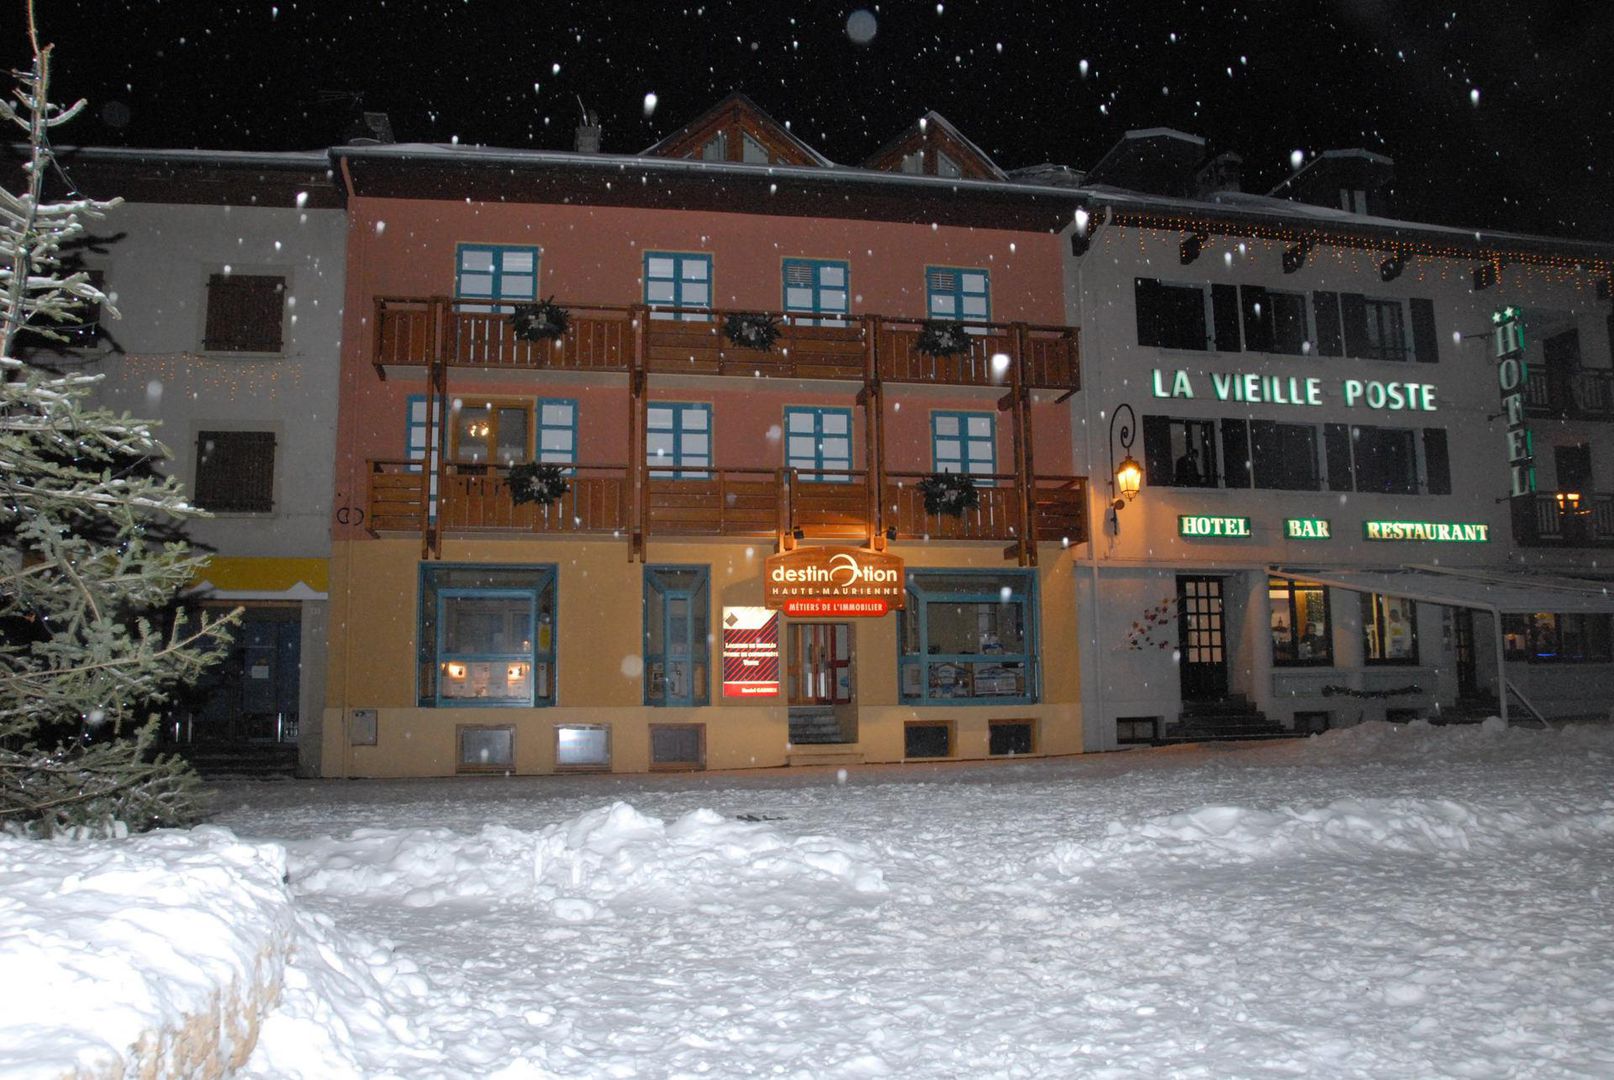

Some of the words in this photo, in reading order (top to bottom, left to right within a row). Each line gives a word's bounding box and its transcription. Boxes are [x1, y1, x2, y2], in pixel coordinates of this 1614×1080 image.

[1152, 369, 1194, 398] LA
[1210, 372, 1323, 405] VIEILLE
[1344, 379, 1437, 411] POSTE
[1495, 321, 1533, 497] HOTEL
[1182, 516, 1250, 537] HOTEL
[1288, 520, 1330, 538] BAR
[1367, 522, 1489, 541] RESTAURANT
[772, 587, 898, 595] HAUTE-MAURIENNE
[789, 602, 819, 611] MÉTIERS
[821, 603, 831, 611] DE
[833, 603, 883, 611] L'IMMOBILIER
